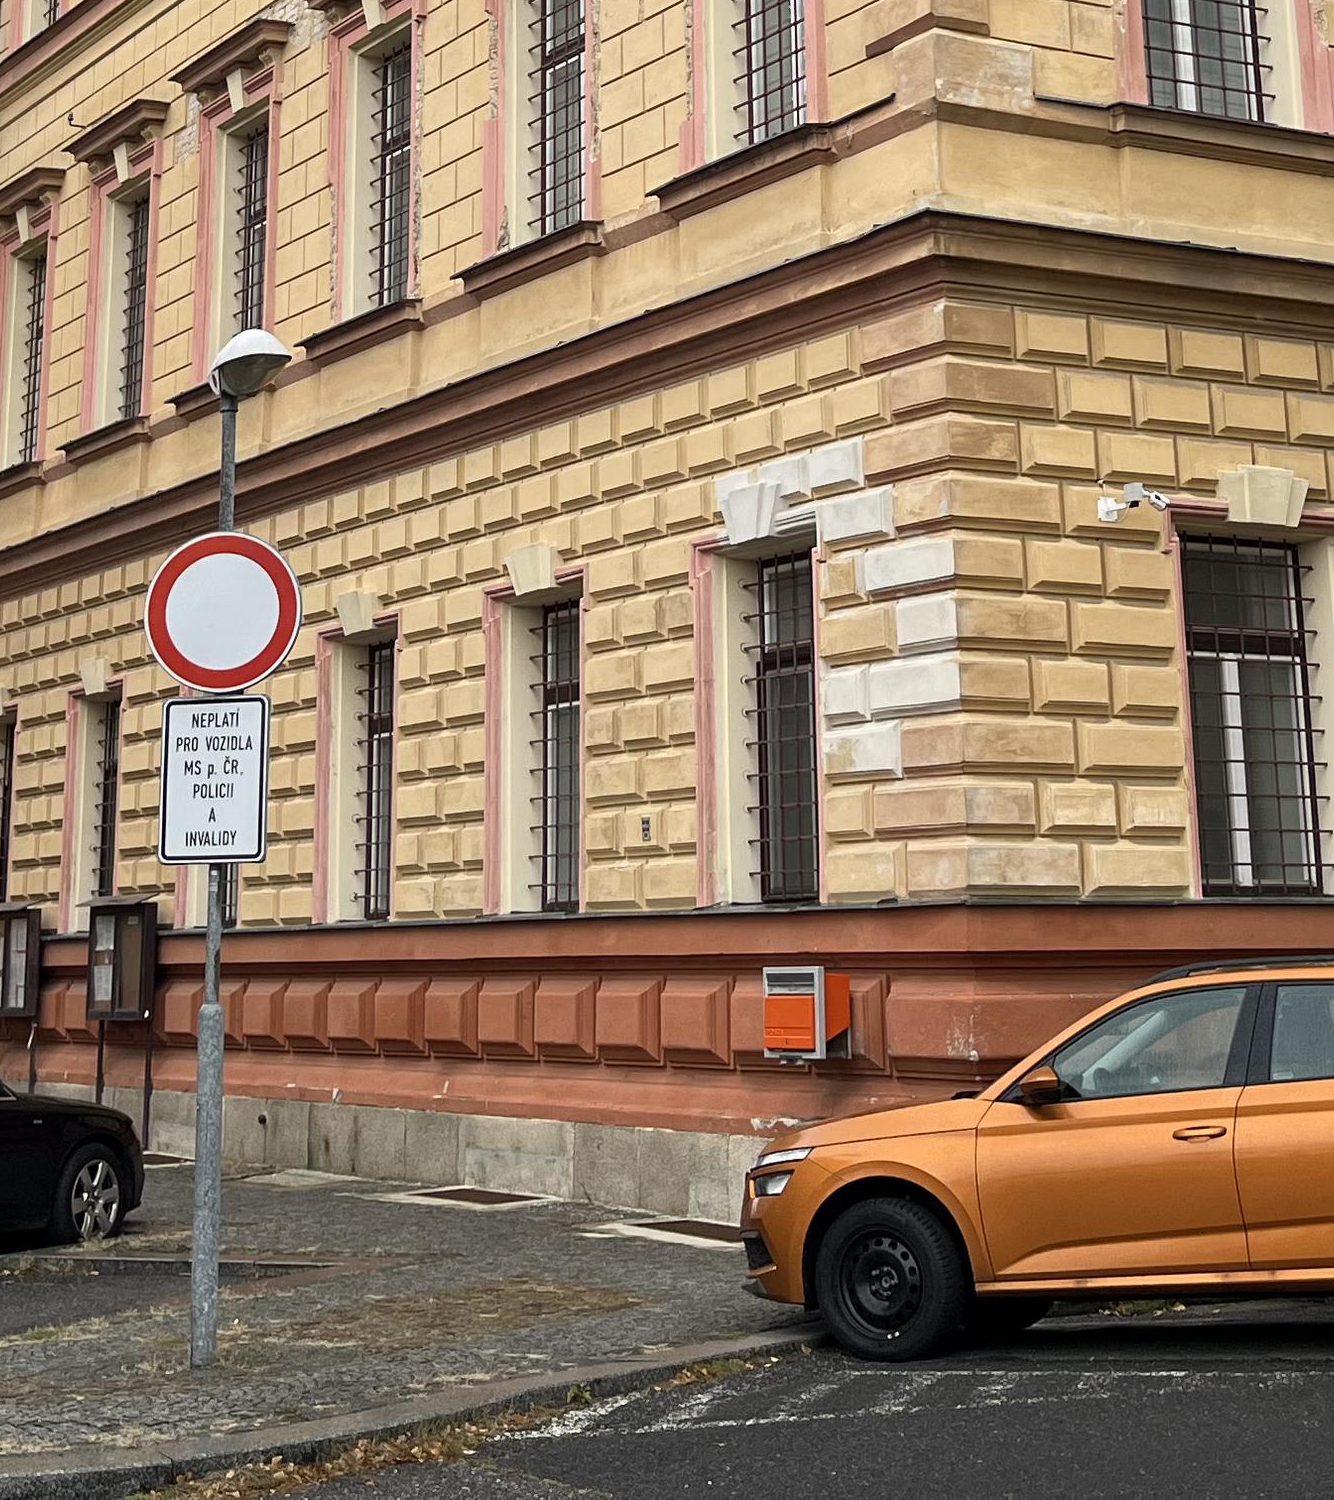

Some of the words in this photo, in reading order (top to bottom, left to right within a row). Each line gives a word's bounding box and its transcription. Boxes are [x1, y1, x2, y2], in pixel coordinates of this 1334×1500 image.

[191, 708, 240, 728] NEPLATÍ
[175, 736, 199, 752] PRO
[205, 735, 253, 751] VOZIDLA
[184, 760, 202, 776] MS
[207, 763, 218, 779] p.
[192, 782, 234, 799] POLICII
[208, 807, 216, 822] A
[185, 830, 237, 847] INVALIDY
